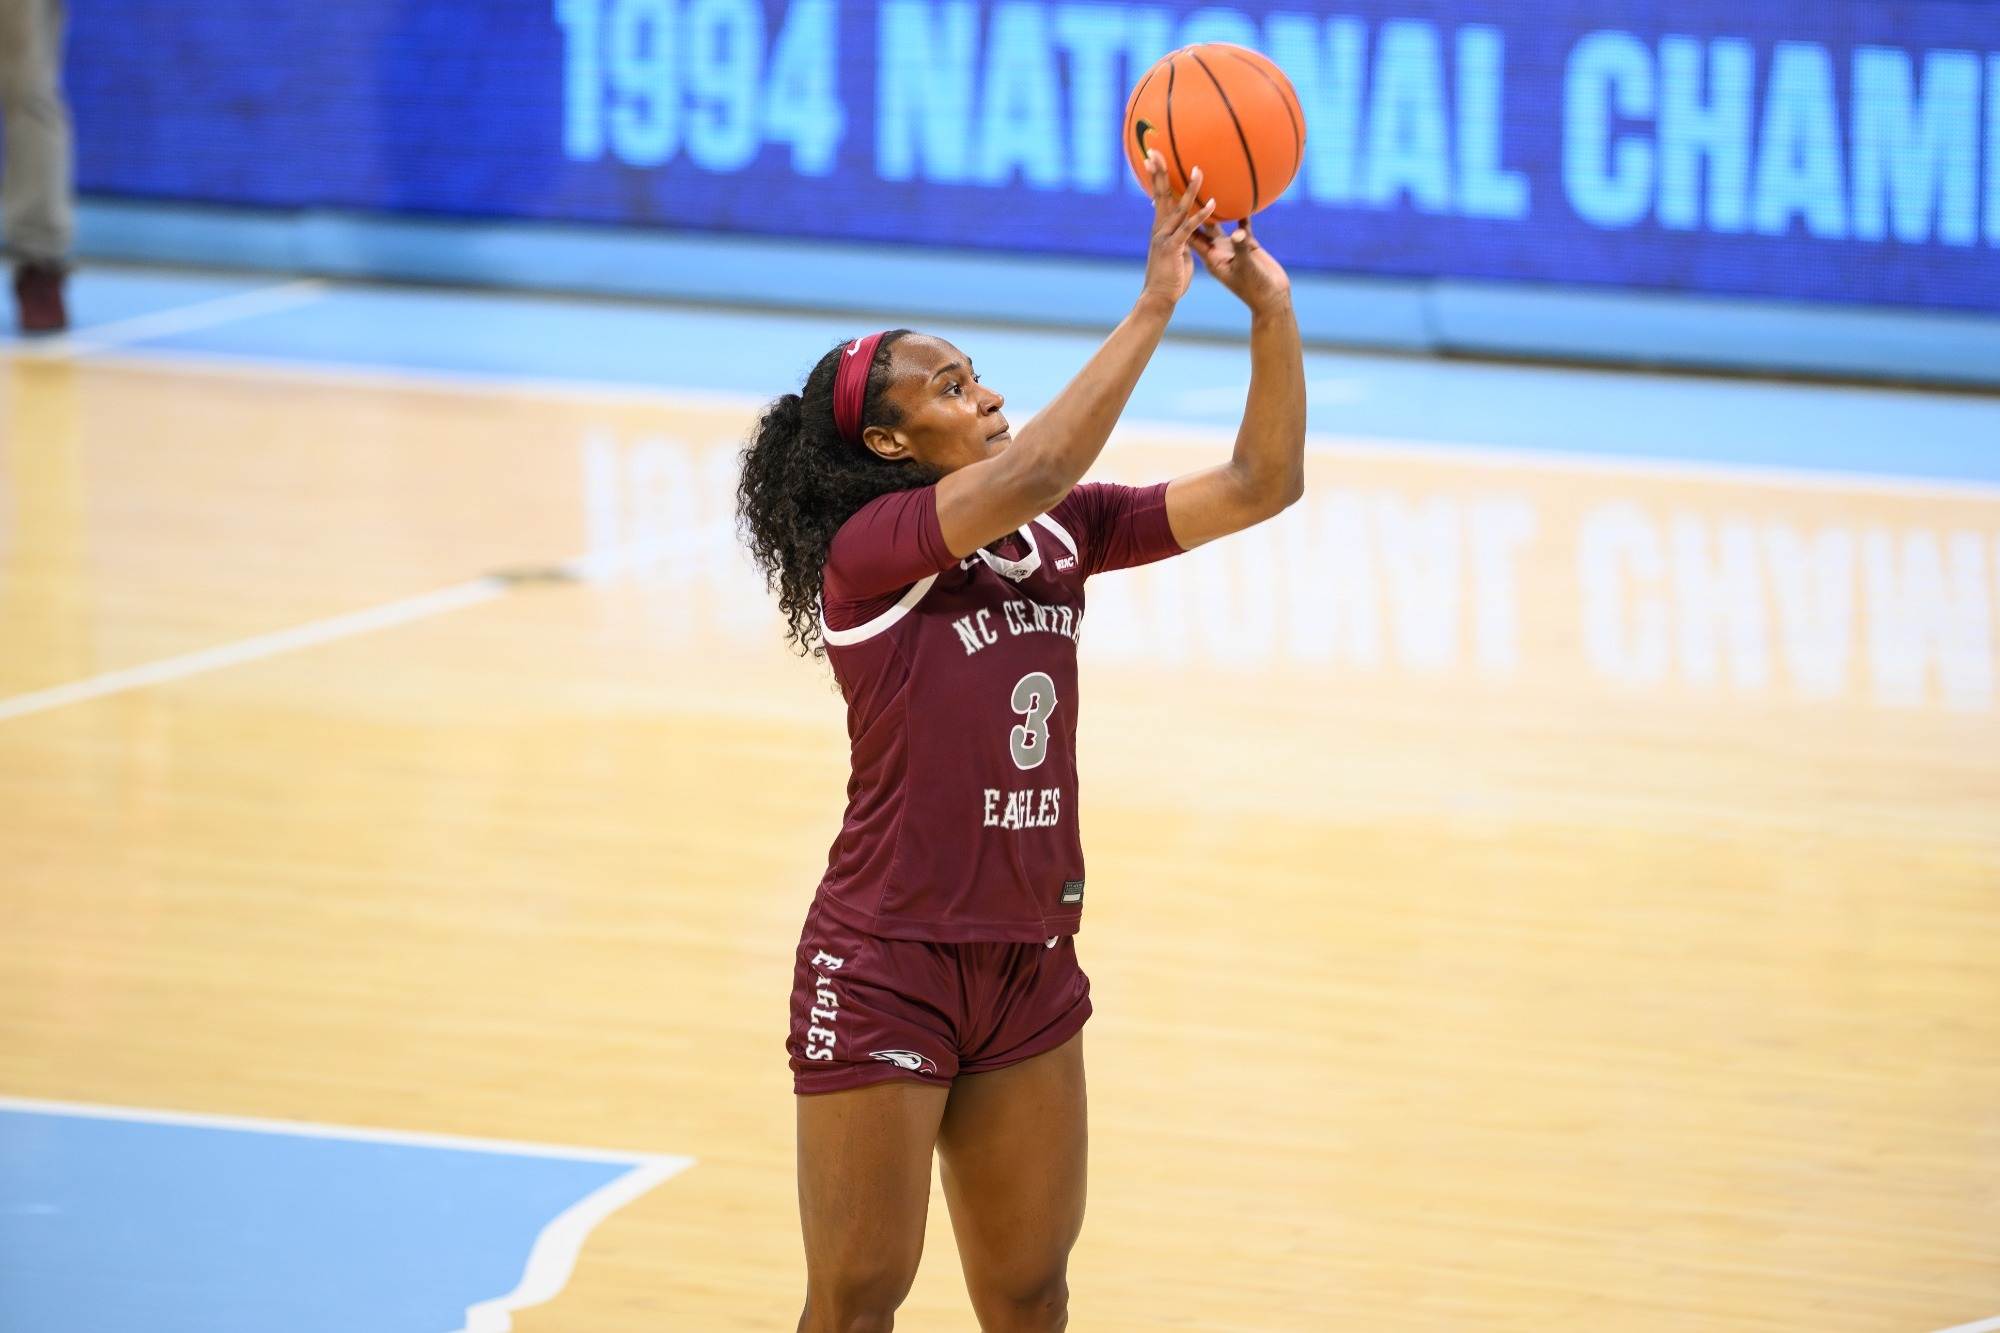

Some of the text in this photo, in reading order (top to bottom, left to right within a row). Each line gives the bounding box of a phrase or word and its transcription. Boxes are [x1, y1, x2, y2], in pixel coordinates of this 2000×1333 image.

[555, 0, 2000, 249] 1994 NATNAL CHAM
[952, 606, 998, 656] NC
[1010, 671, 1058, 770] 3
[983, 787, 1060, 830] EAGLES
